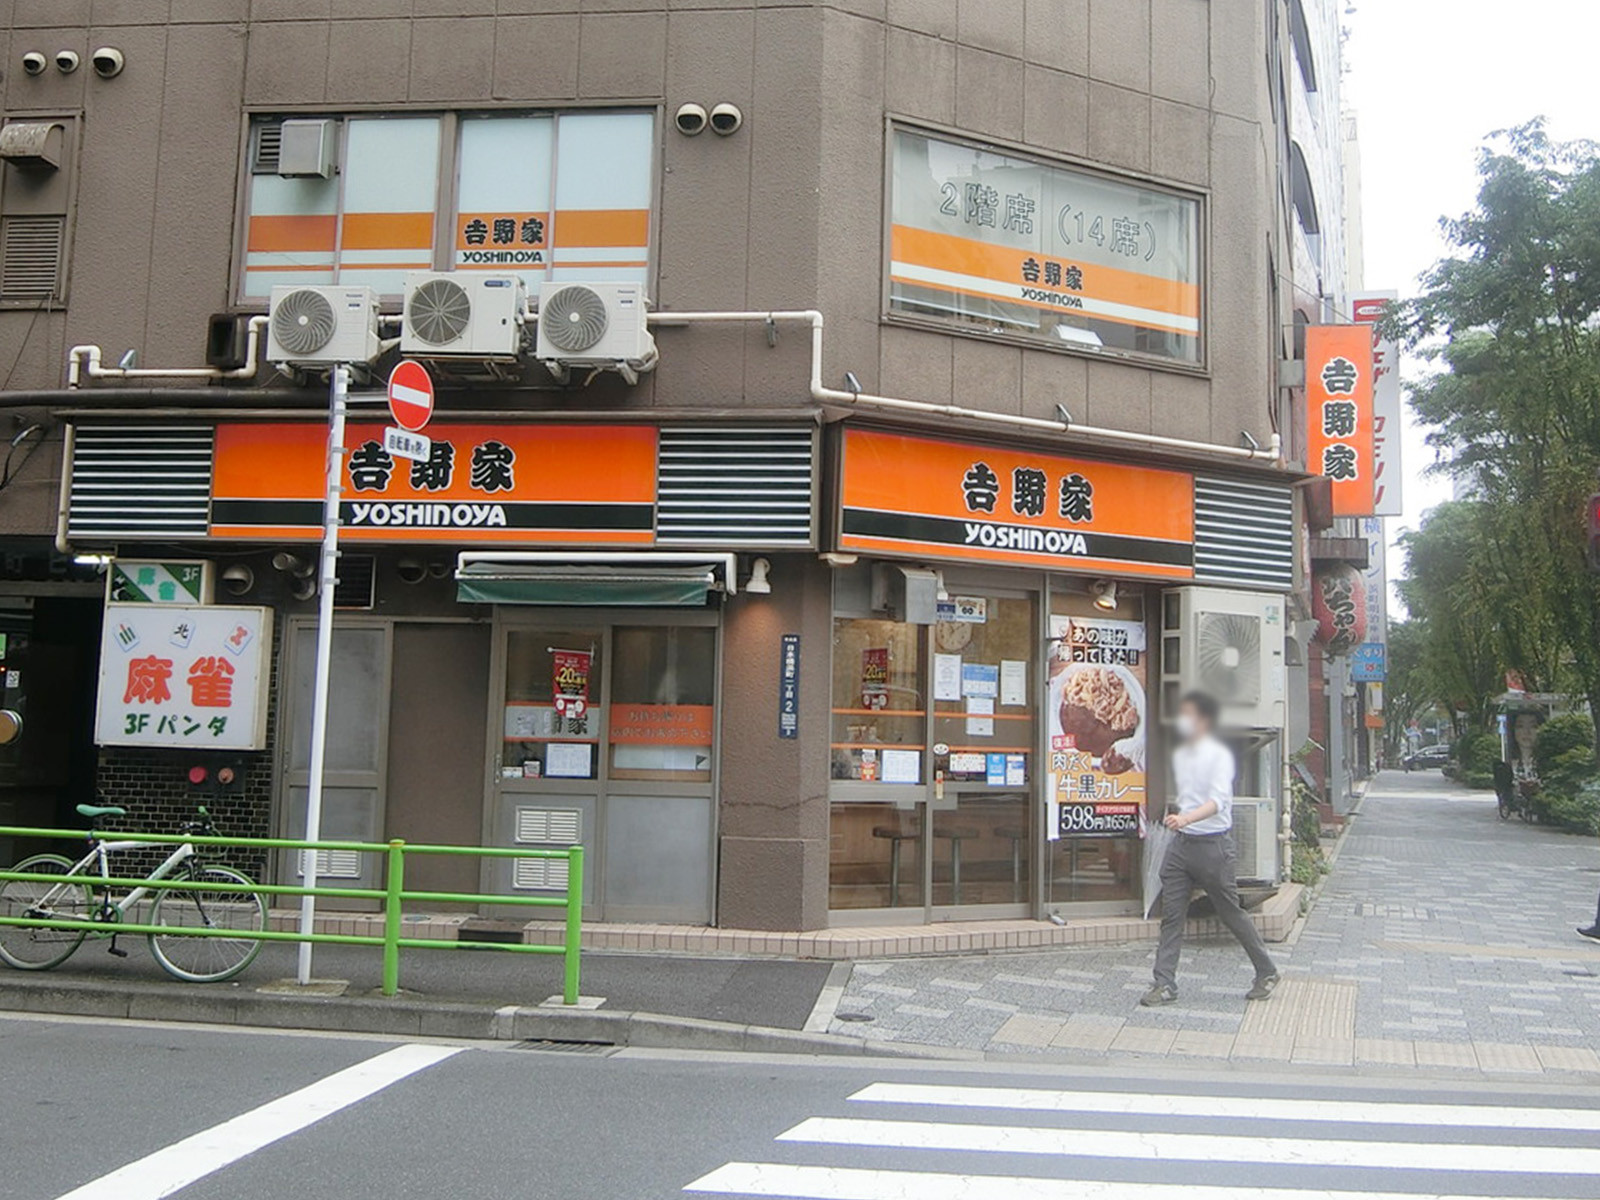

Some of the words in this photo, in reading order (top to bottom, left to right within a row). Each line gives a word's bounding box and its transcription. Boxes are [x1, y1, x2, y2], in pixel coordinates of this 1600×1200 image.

[939, 181, 1036, 236] 2階席
[462, 250, 544, 264] YOSHINOYA
[1020, 287, 1084, 310] YOSHINOYA
[352, 503, 508, 526] YOSHINOYA
[964, 523, 1088, 556] YOSHINOYA
[182, 567, 200, 582] 3F
[122, 654, 236, 709] 麻雀
[1058, 773, 1145, 800] 牛黒カレー
